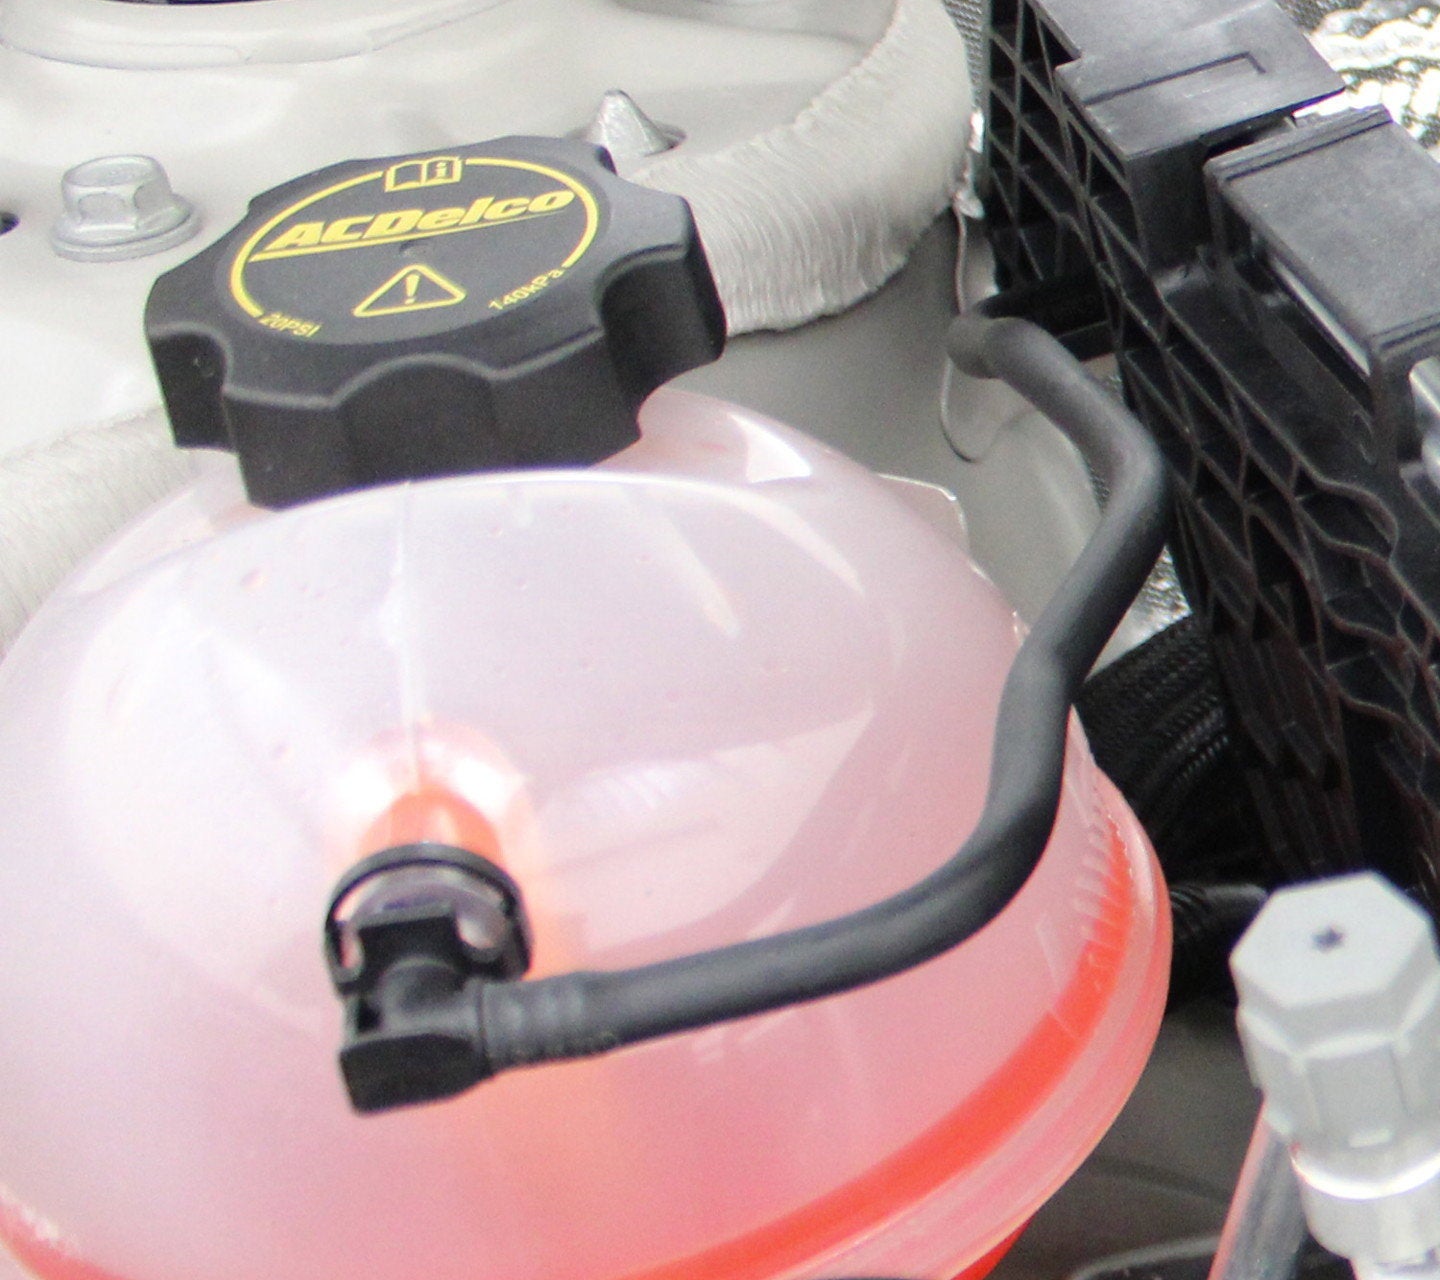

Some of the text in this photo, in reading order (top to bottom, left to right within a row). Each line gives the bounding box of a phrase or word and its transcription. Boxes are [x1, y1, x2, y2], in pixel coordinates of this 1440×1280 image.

[258, 190, 576, 253] ACDelco
[488, 267, 565, 312] 140kPa
[258, 311, 322, 338] 20PSI
